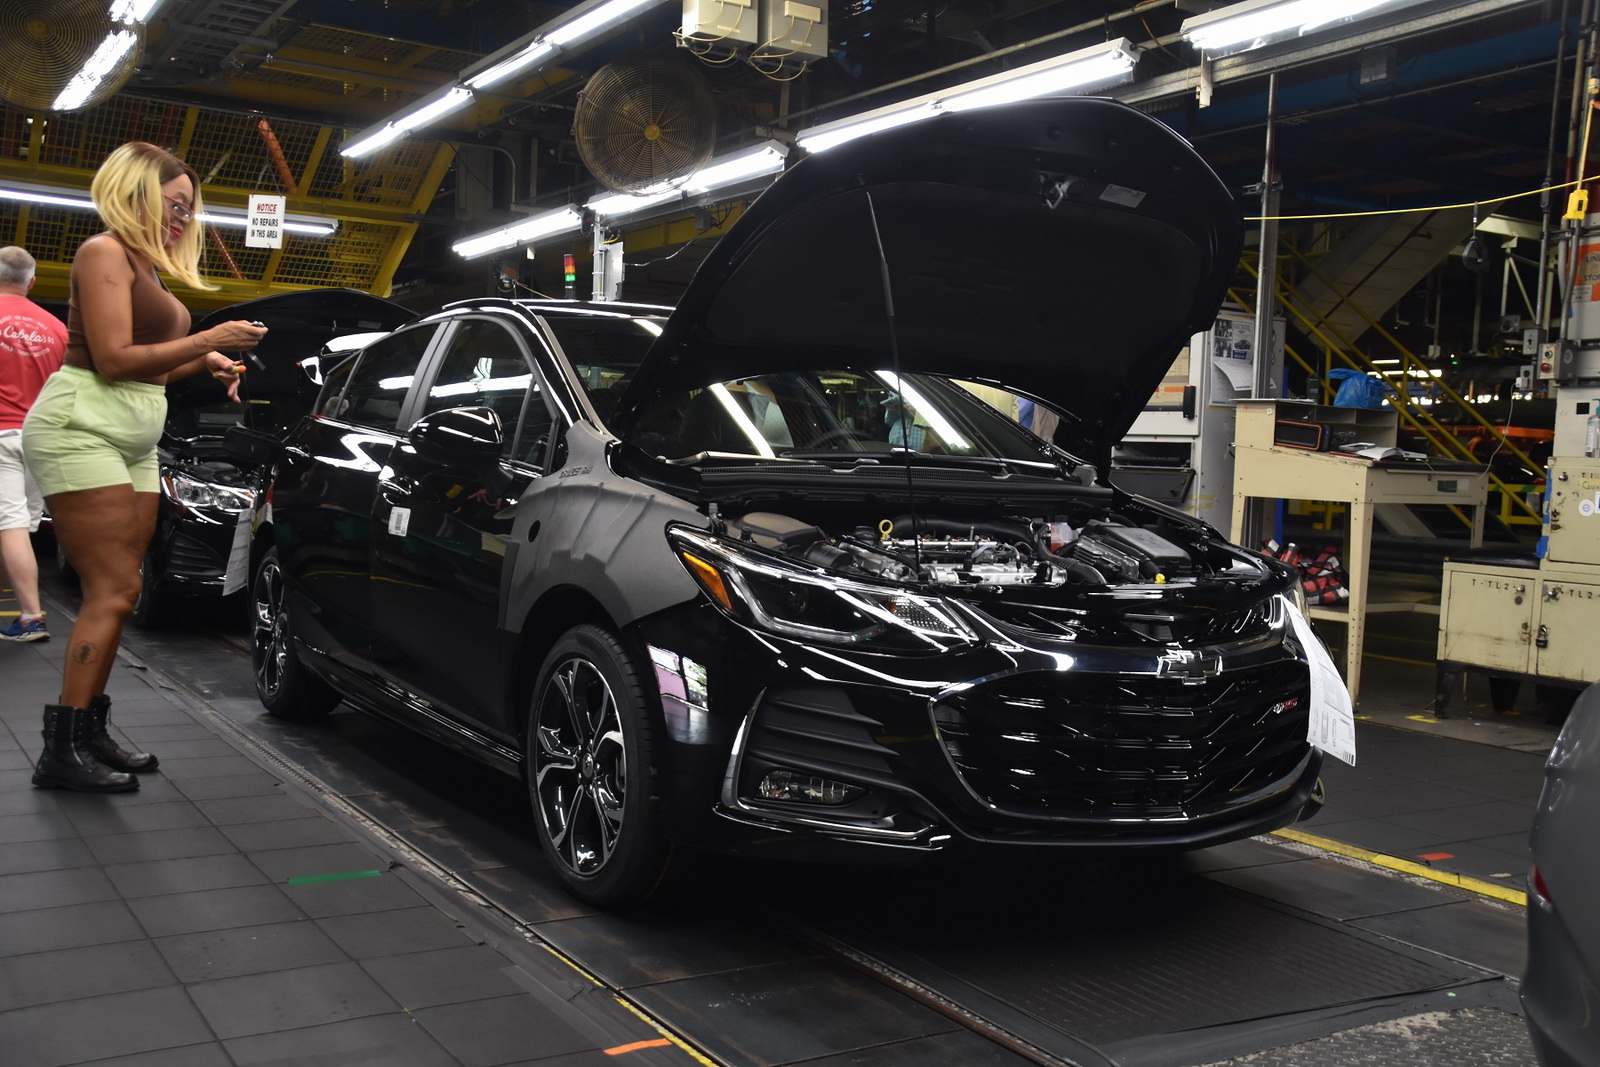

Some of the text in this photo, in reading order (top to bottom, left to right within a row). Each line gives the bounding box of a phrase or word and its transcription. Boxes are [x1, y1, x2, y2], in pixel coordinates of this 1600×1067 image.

[256, 203, 278, 212] NOTICE
[252, 218, 279, 227] NO REPAIRS
[251, 229, 278, 239] IN THIS AREA
[3, 324, 47, 343] Cabela's
